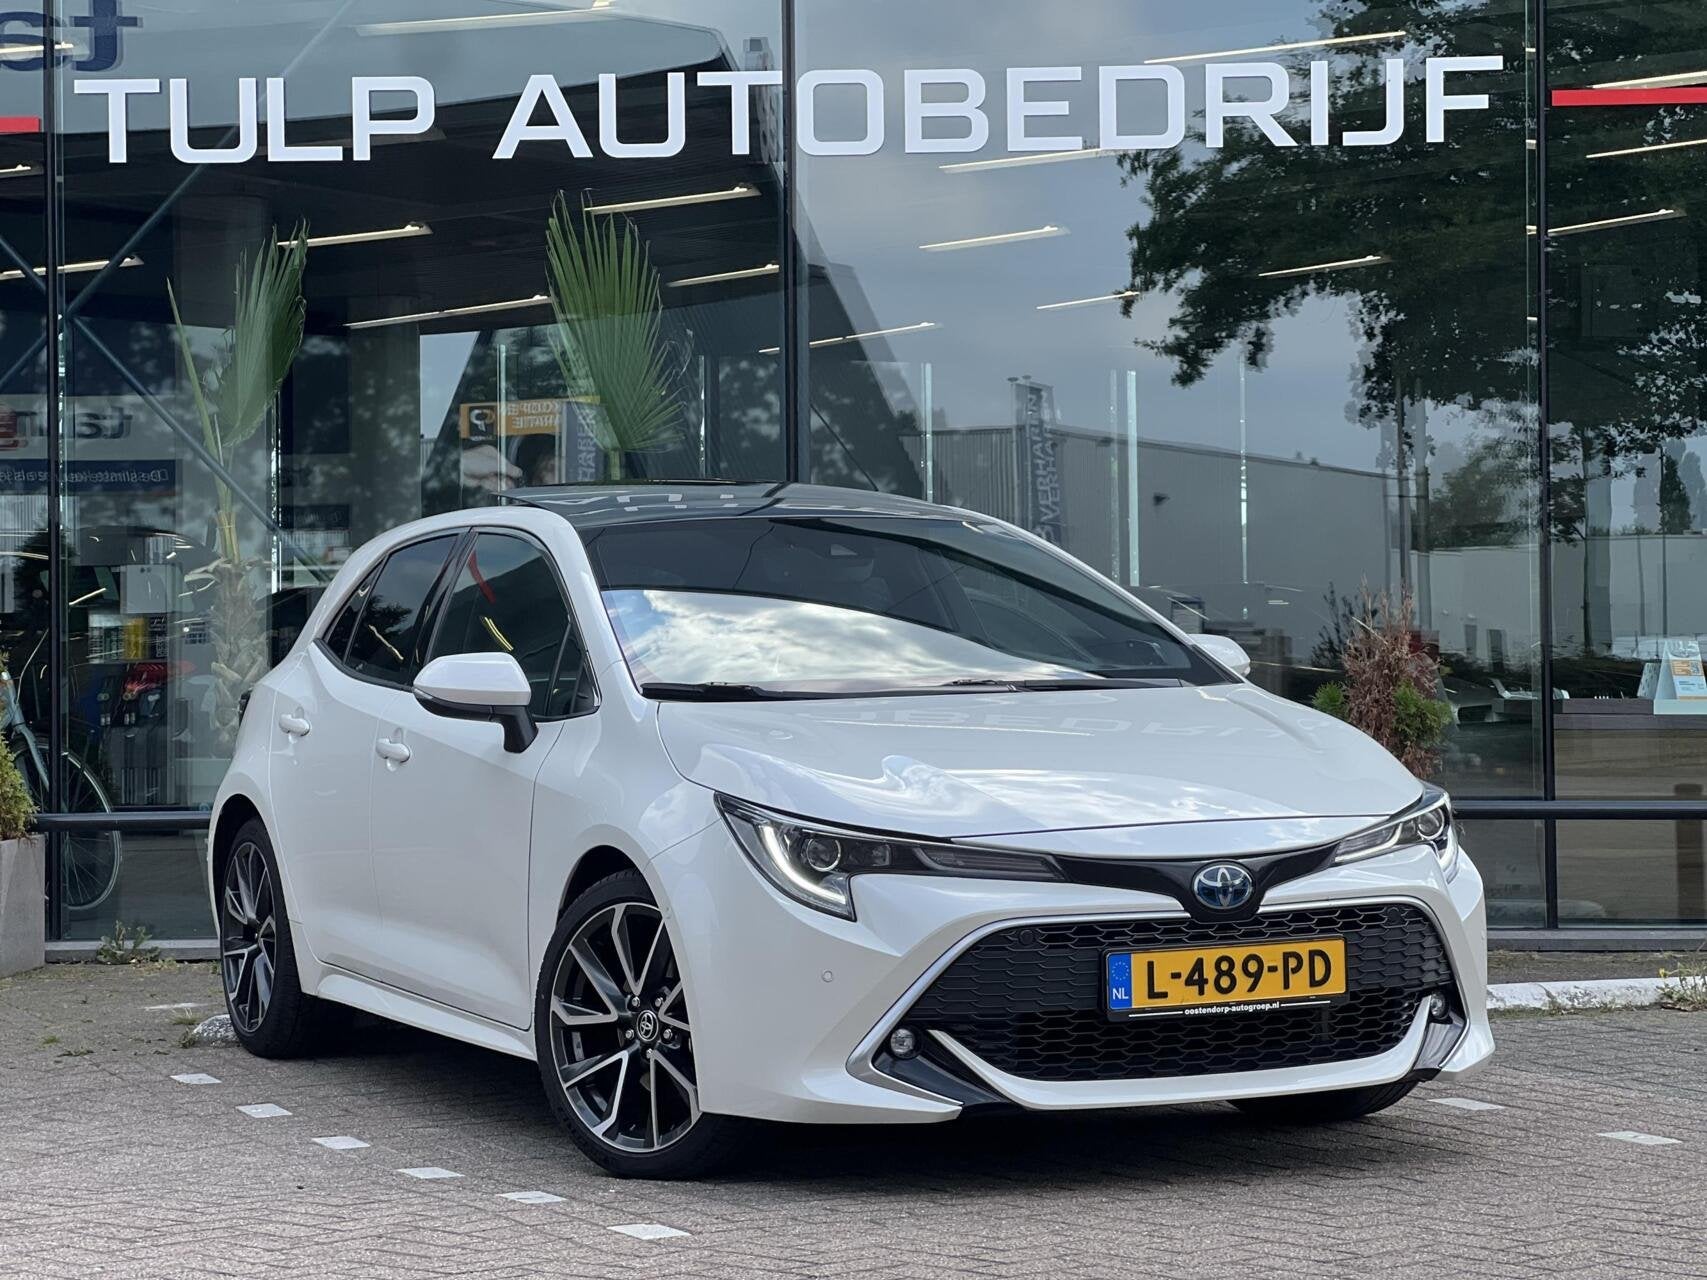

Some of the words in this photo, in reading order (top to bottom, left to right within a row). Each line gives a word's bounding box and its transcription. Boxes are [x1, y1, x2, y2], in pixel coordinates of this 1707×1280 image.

[73, 76, 436, 164] TULP
[492, 56, 1504, 160] AUTOBEDRIJF
[1146, 949, 1332, 1000] L-489-PD
[1112, 987, 1129, 1000] NL
[1184, 1001, 1280, 1015] oostendorp-autogroep.nl
